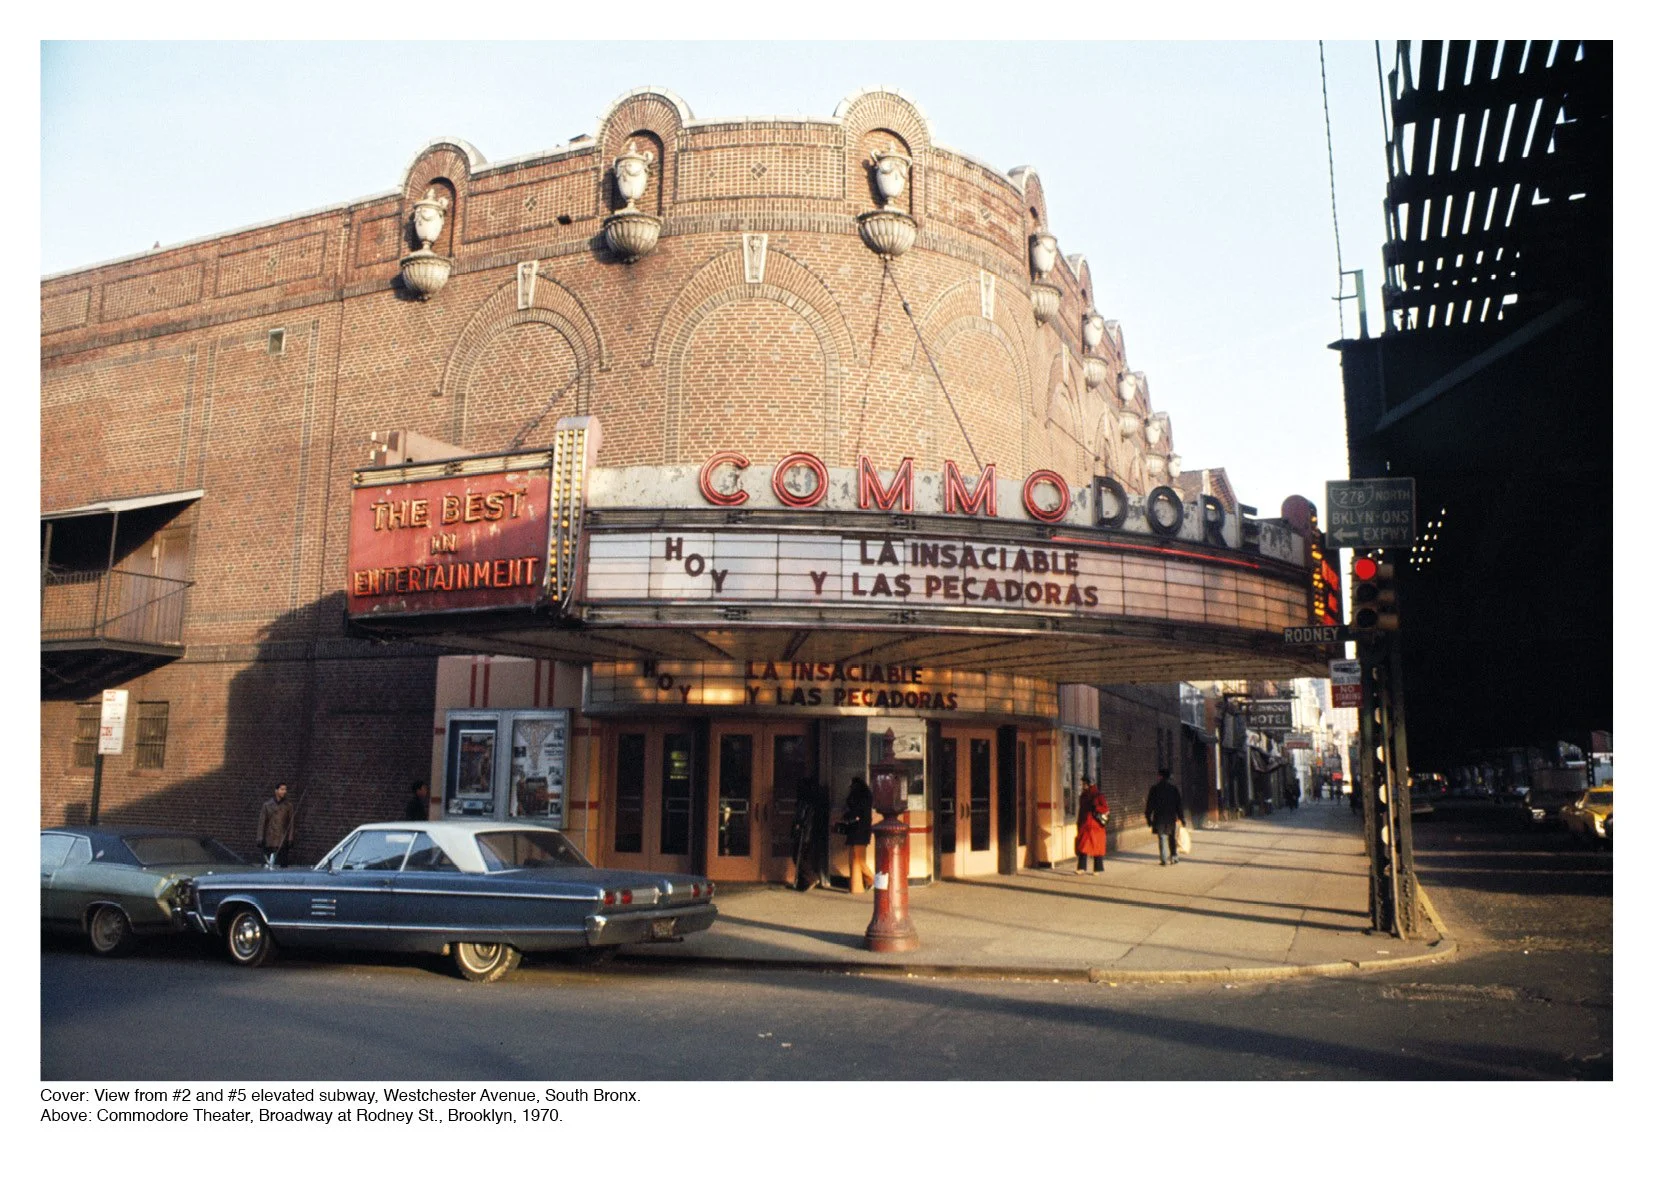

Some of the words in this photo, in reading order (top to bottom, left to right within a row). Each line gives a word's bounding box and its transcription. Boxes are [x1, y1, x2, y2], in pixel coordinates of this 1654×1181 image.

[371, 499, 428, 531] THE
[441, 488, 527, 526] BEST
[699, 451, 1258, 552] COMMODORE
[1339, 490, 1366, 505] 278
[1375, 489, 1410, 501] NORTH
[429, 532, 458, 555] IN
[1363, 527, 1408, 541] EXPWY
[861, 539, 899, 568] LA
[911, 542, 1079, 577] INSACIABLE
[353, 556, 539, 597] ENTERTAINMENT
[810, 571, 828, 595] Y
[852, 571, 911, 598] LAS
[925, 575, 1099, 608] PECADORAS
[1284, 626, 1340, 643] RODNEY
[747, 660, 778, 681] LA
[790, 660, 924, 685] INSACIABLE
[746, 684, 761, 703] Y
[776, 686, 823, 706] LAS
[834, 687, 959, 711] PECADORAS
[1340, 685, 1355, 693] NO
[1250, 714, 1287, 724] HOTEL
